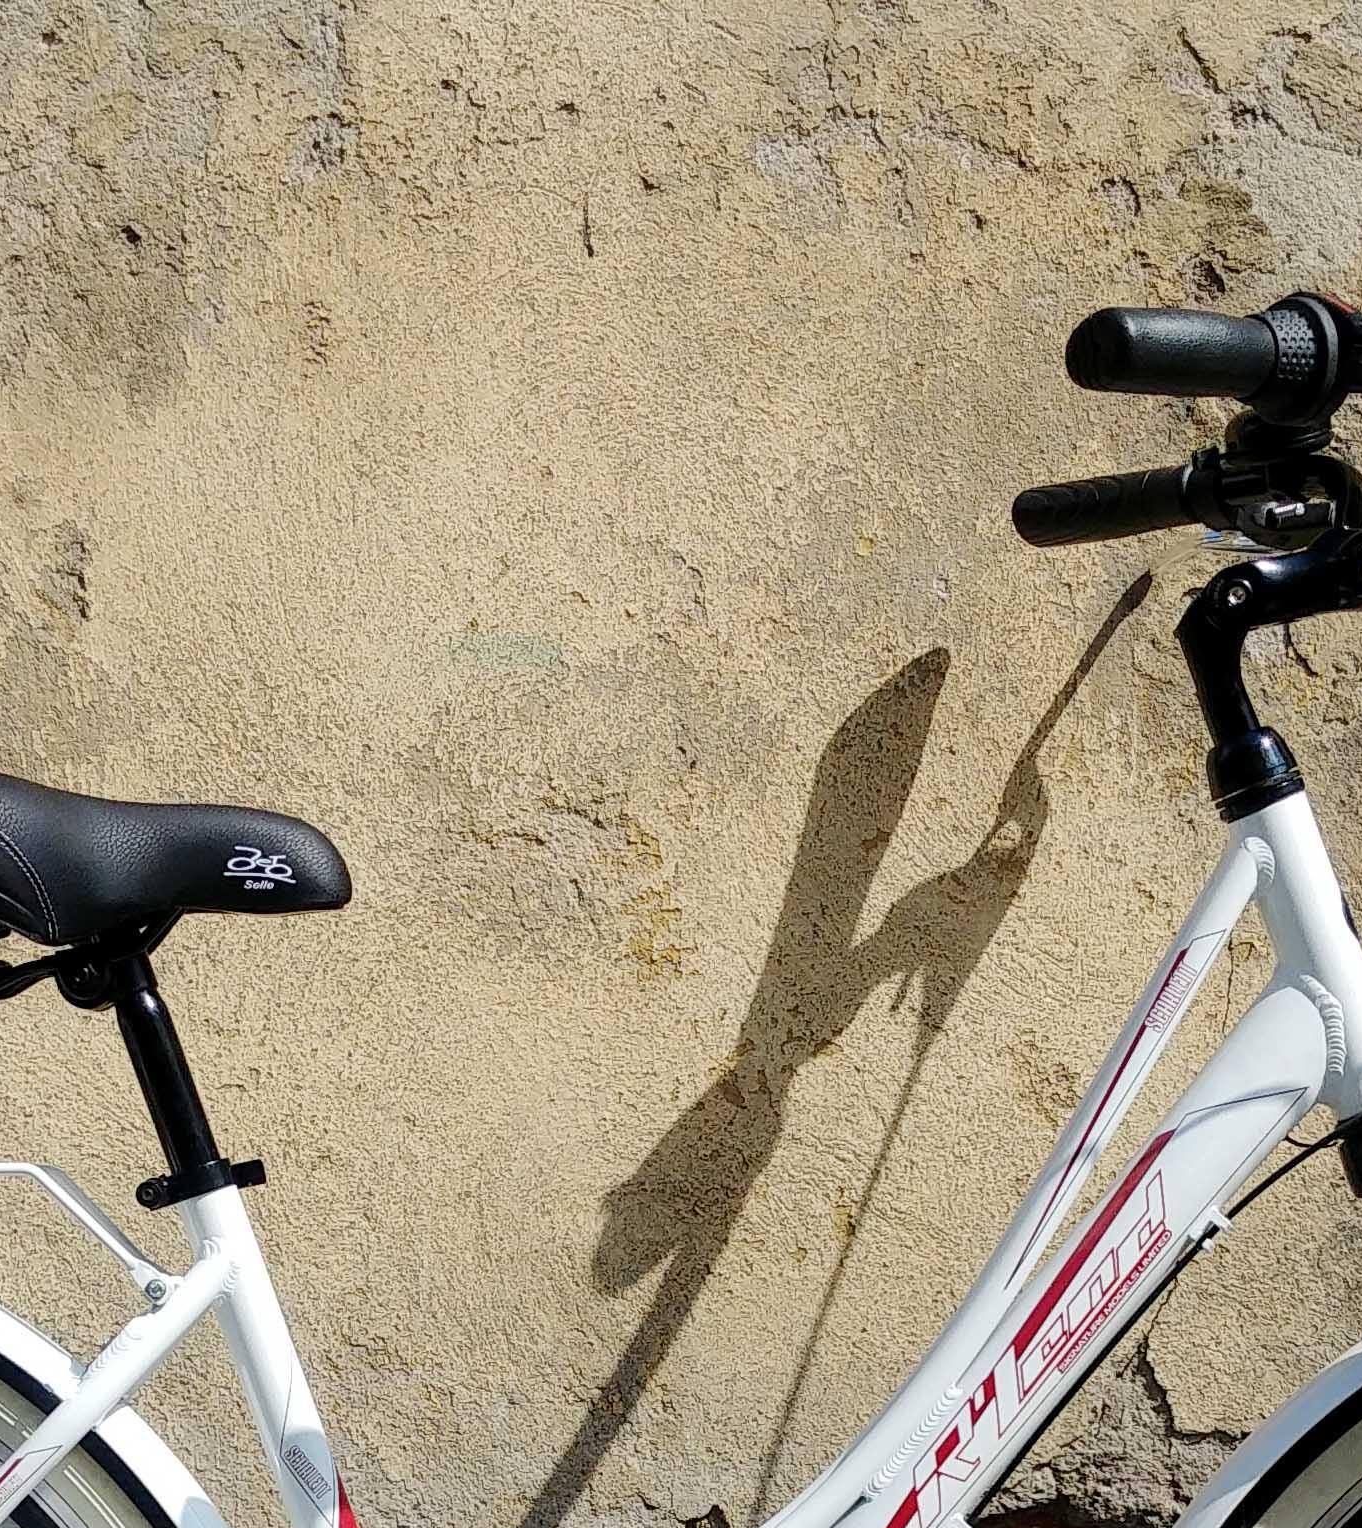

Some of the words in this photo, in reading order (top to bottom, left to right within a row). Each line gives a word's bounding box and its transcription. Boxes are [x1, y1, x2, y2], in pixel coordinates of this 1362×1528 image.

[1055, 1311, 1107, 1373] SIGNATURE
[1100, 1269, 1141, 1316] MODELS
[1135, 1229, 1173, 1273] LIMITED
